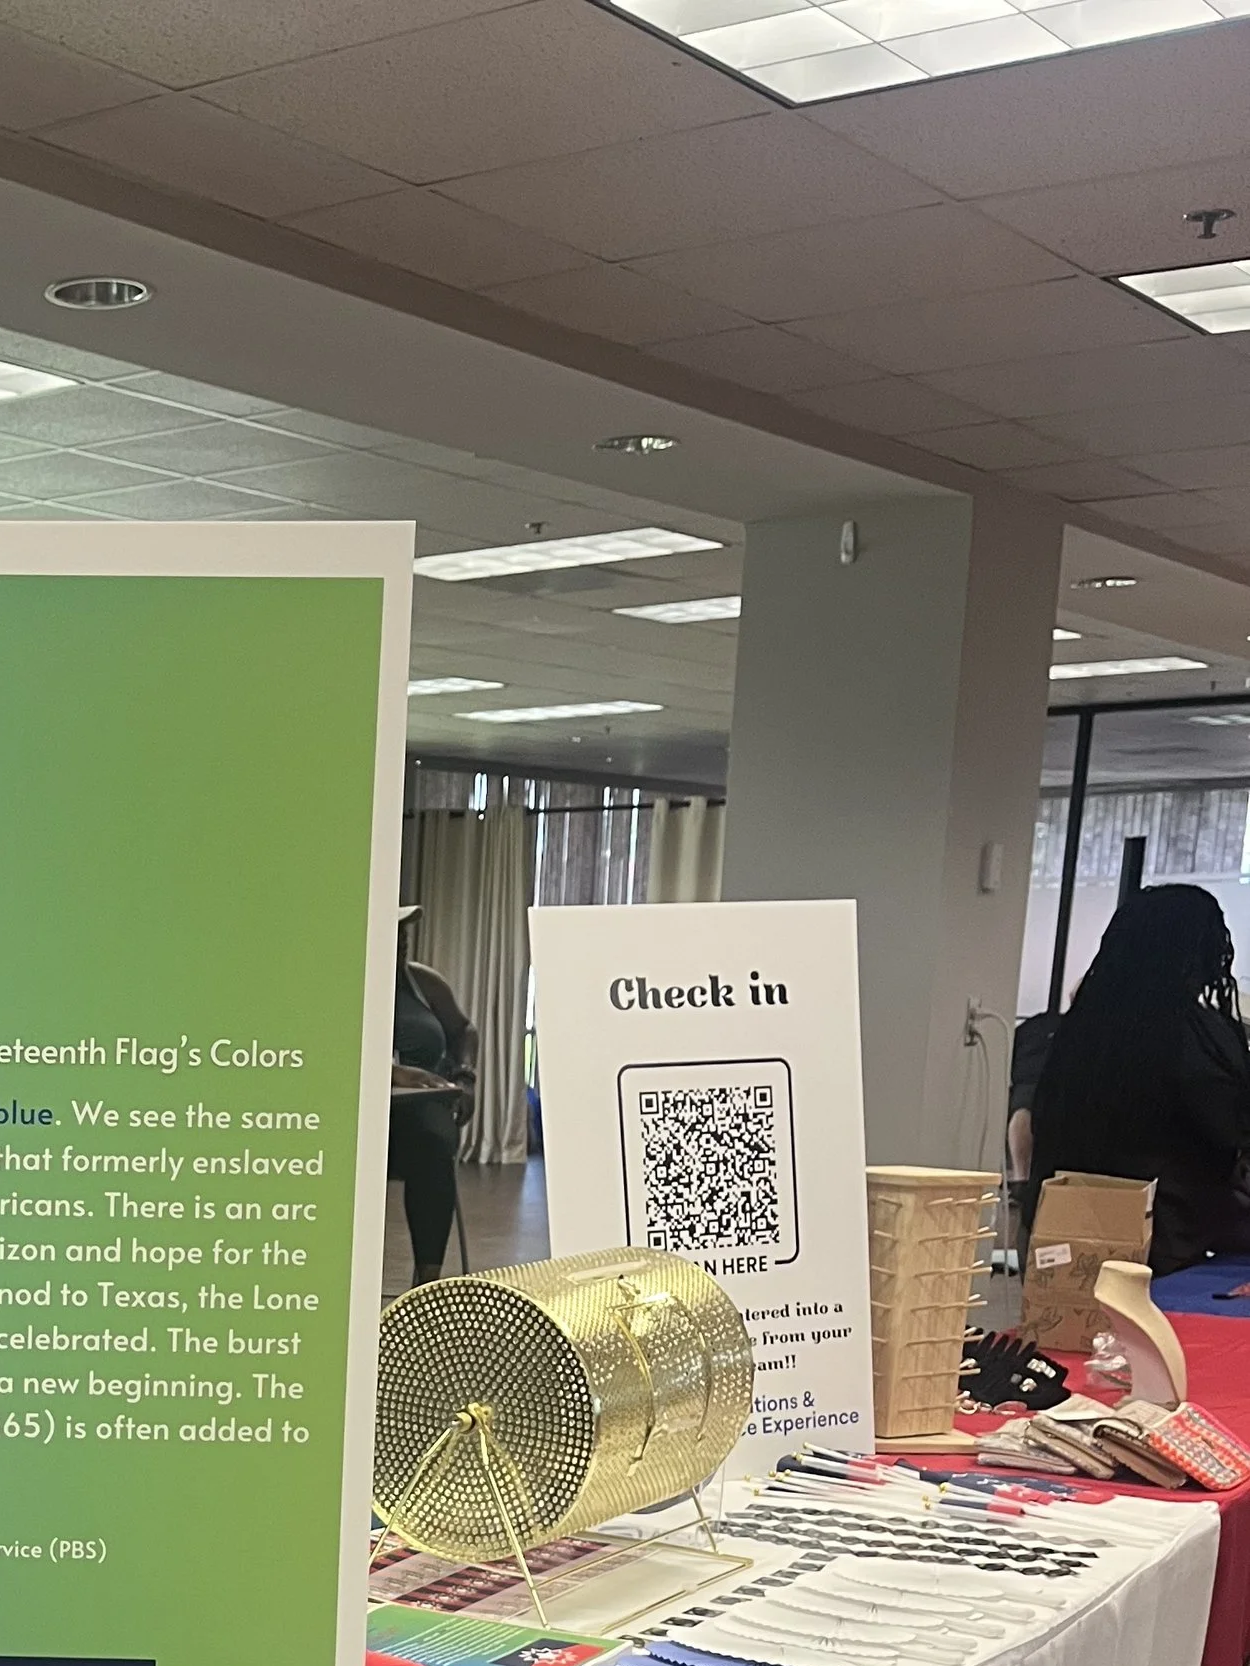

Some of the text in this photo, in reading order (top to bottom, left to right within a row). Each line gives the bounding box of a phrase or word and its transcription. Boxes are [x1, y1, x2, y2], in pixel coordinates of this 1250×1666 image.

[609, 970, 789, 1011] Check in
[210, 1038, 303, 1068] Colors
[71, 1100, 119, 1127] We
[129, 1109, 176, 1127] see
[185, 1102, 231, 1128] the
[240, 1111, 320, 1129] same
[61, 1145, 184, 1181] formerly
[192, 1148, 323, 1175] enslaved
[104, 1191, 184, 1218] There
[194, 1194, 215, 1219] is
[225, 1202, 261, 1219] an
[271, 1203, 316, 1220] arc
[65, 1236, 121, 1262] and
[131, 1237, 202, 1271] hope
[212, 1238, 253, 1264] for
[261, 1239, 306, 1265] the
[722, 1256, 768, 1275] HERE
[60, 1283, 88, 1306] to
[97, 1281, 187, 1313] Texas,
[197, 1283, 243, 1309] the
[253, 1284, 318, 1310] Lone
[739, 1301, 843, 1321] tered into a
[166, 1327, 218, 1353] The
[228, 1328, 301, 1354] burst
[762, 1331, 805, 1346] from
[811, 1327, 852, 1344] your
[23, 1377, 79, 1394] new
[88, 1370, 241, 1405] beginning.
[252, 1373, 303, 1399] The
[750, 1391, 815, 1413] tions &
[66, 1415, 86, 1439] is
[95, 1414, 168, 1440] often
[178, 1416, 271, 1442] added
[281, 1420, 309, 1443] to
[763, 1411, 860, 1436] Experience
[49, 1537, 106, 1563] (PBS)
